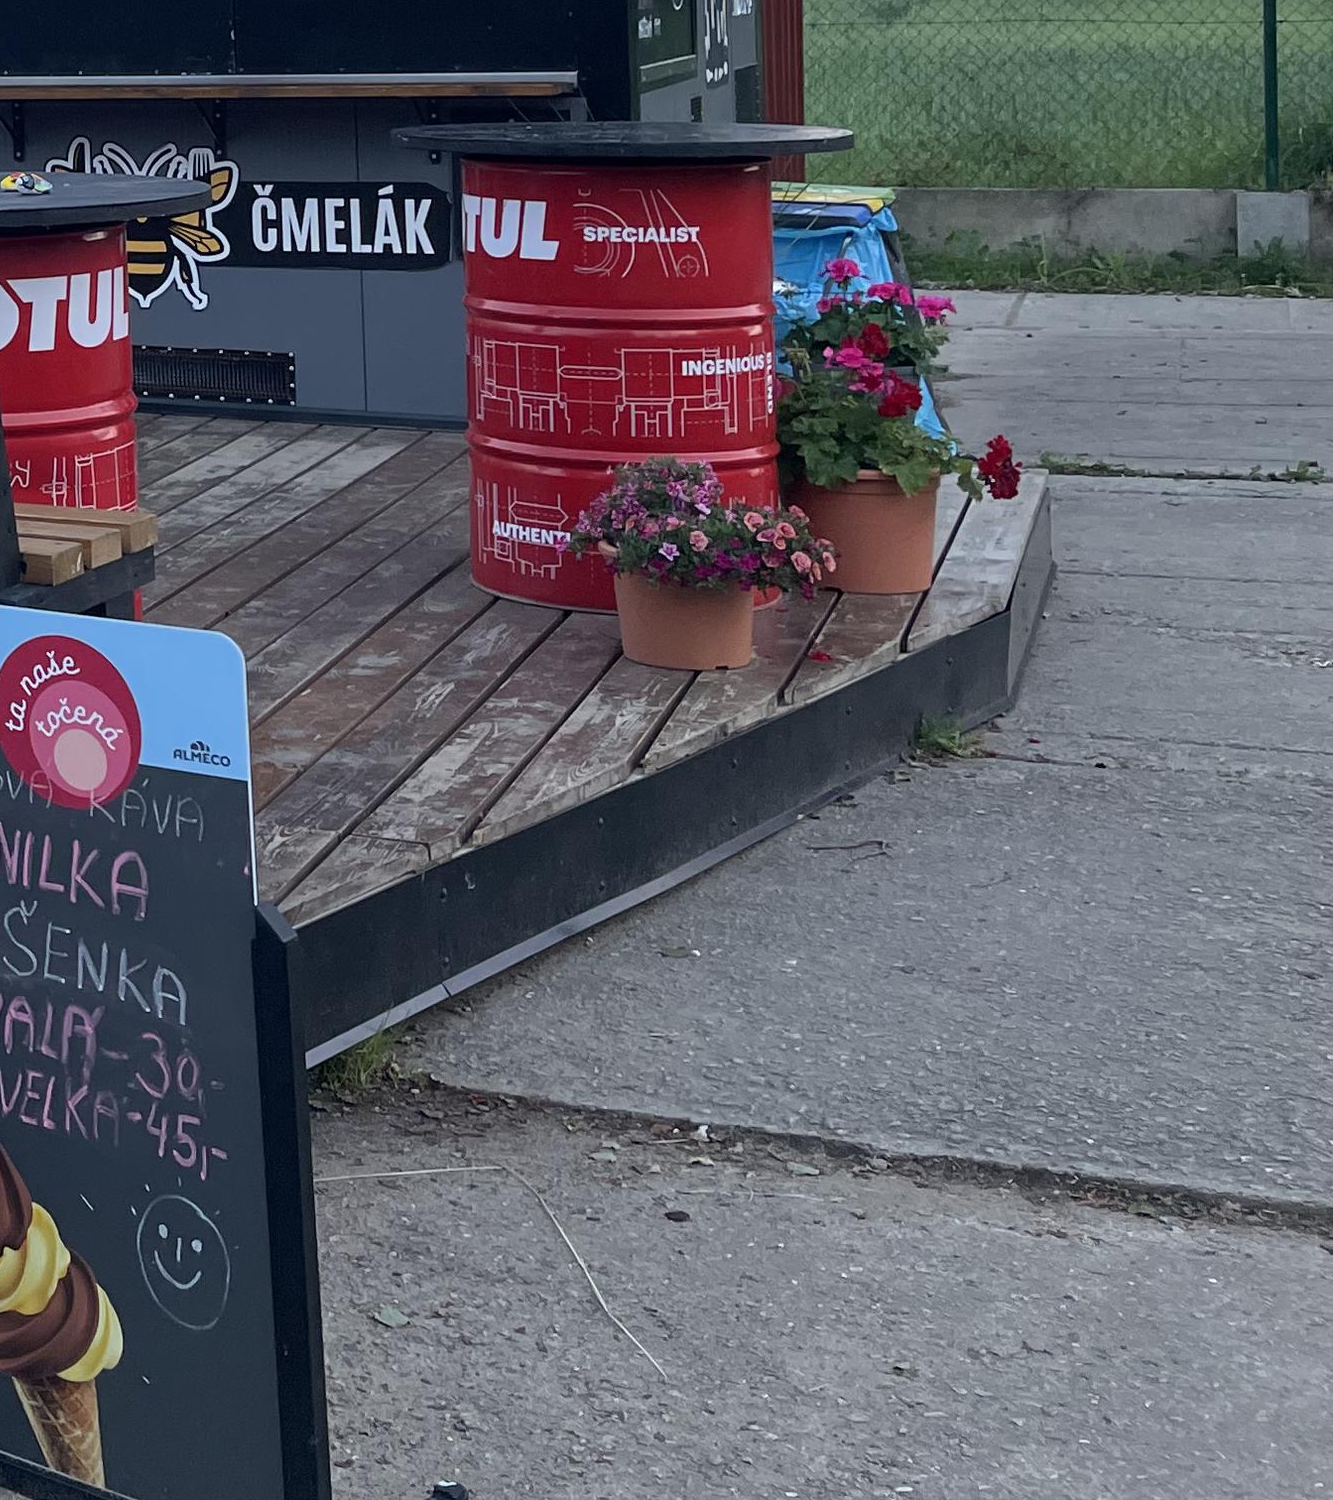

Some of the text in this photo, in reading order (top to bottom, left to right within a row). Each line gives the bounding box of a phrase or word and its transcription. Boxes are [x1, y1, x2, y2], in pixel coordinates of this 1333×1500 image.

[252, 184, 435, 255] ČMELÁK
[583, 226, 700, 244] SPECIALIST
[682, 354, 765, 376] INGENIOUS
[5, 650, 81, 731] ta naše
[35, 697, 124, 751] točená
[173, 749, 231, 767] ALMECO
[90, 778, 204, 842] KÁVA
